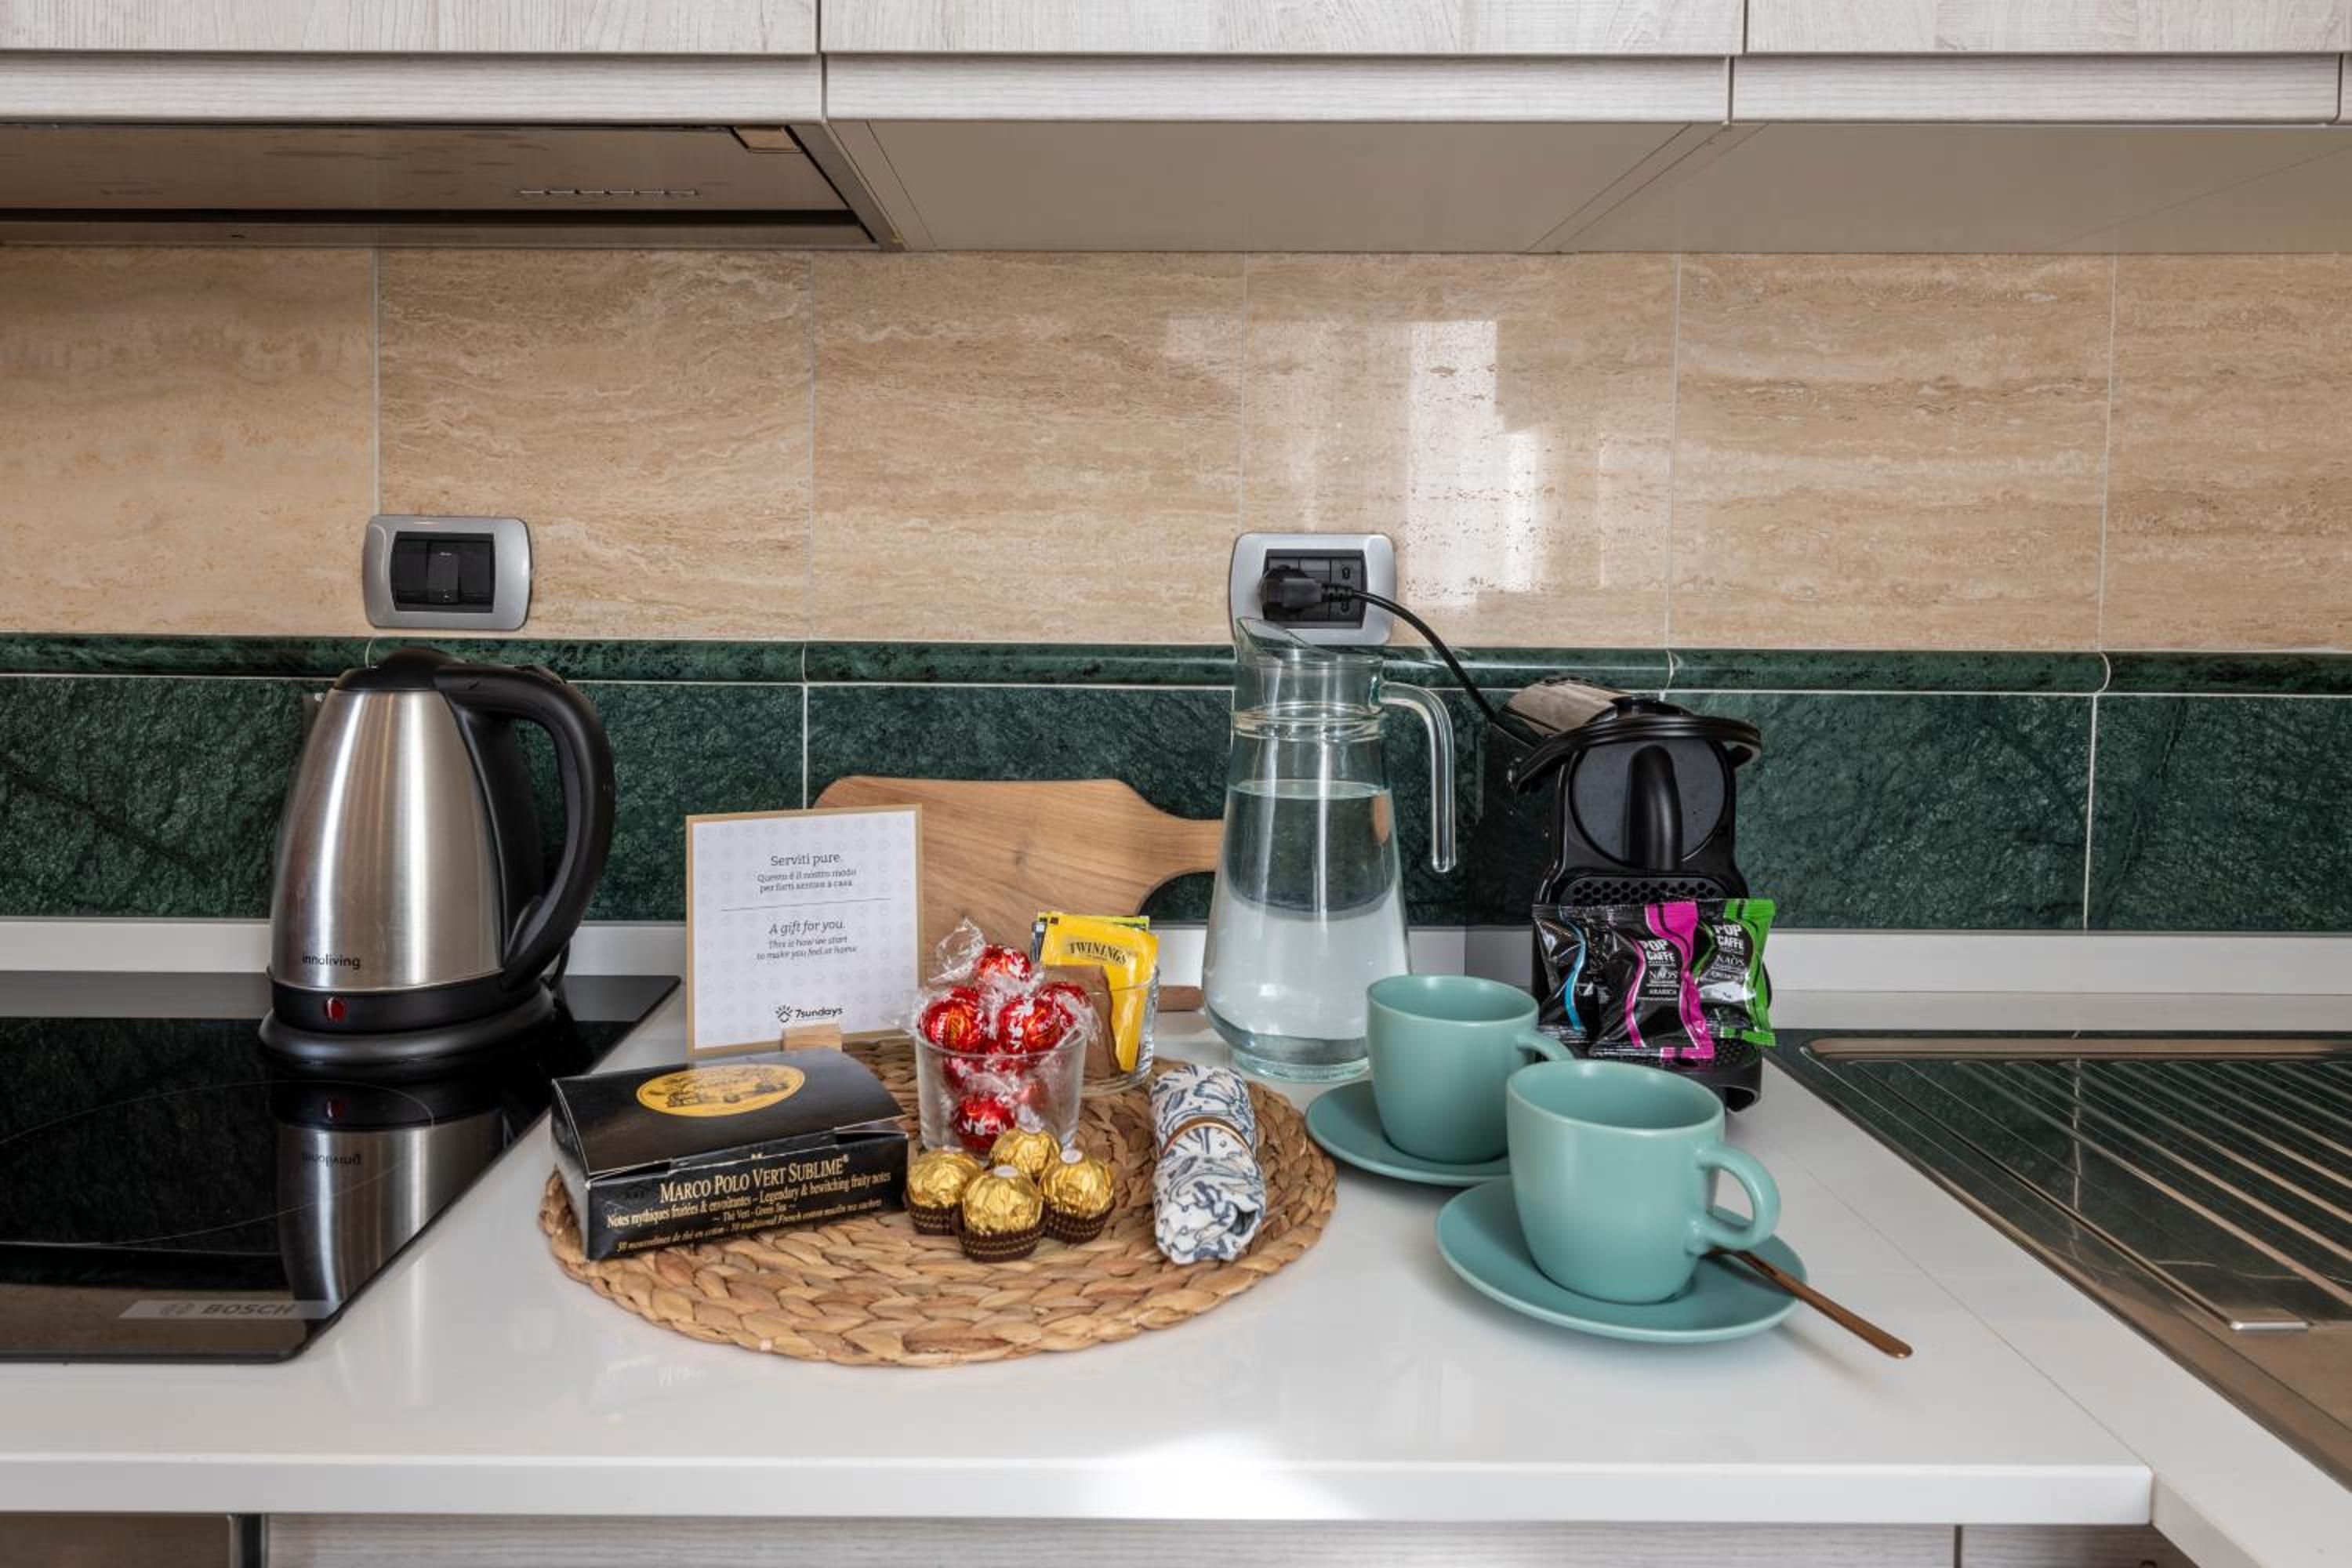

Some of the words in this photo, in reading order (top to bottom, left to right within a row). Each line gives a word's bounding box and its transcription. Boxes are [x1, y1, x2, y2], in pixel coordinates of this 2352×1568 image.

[771, 853, 810, 866] Serviti
[768, 924, 778, 935] A
[780, 920, 801, 936] gift
[802, 920, 821, 935] for
[822, 920, 846, 933] you.
[1070, 942, 1127, 964] TWININGS
[302, 953, 361, 970] innoliving
[795, 1007, 843, 1018] 7sundays
[660, 1179, 712, 1203] MARCO
[714, 1173, 750, 1195] POLO
[753, 1167, 787, 1188] VERT
[607, 1214, 630, 1229] Notes
[632, 1208, 670, 1227] mythiques
[700, 1200, 708, 1213] &
[760, 1185, 799, 1204] Legendary
[801, 1184, 808, 1196] &
[810, 1177, 851, 1195] bewitching
[851, 1173, 870, 1189] fruity
[201, 1303, 297, 1316] BOSCH
